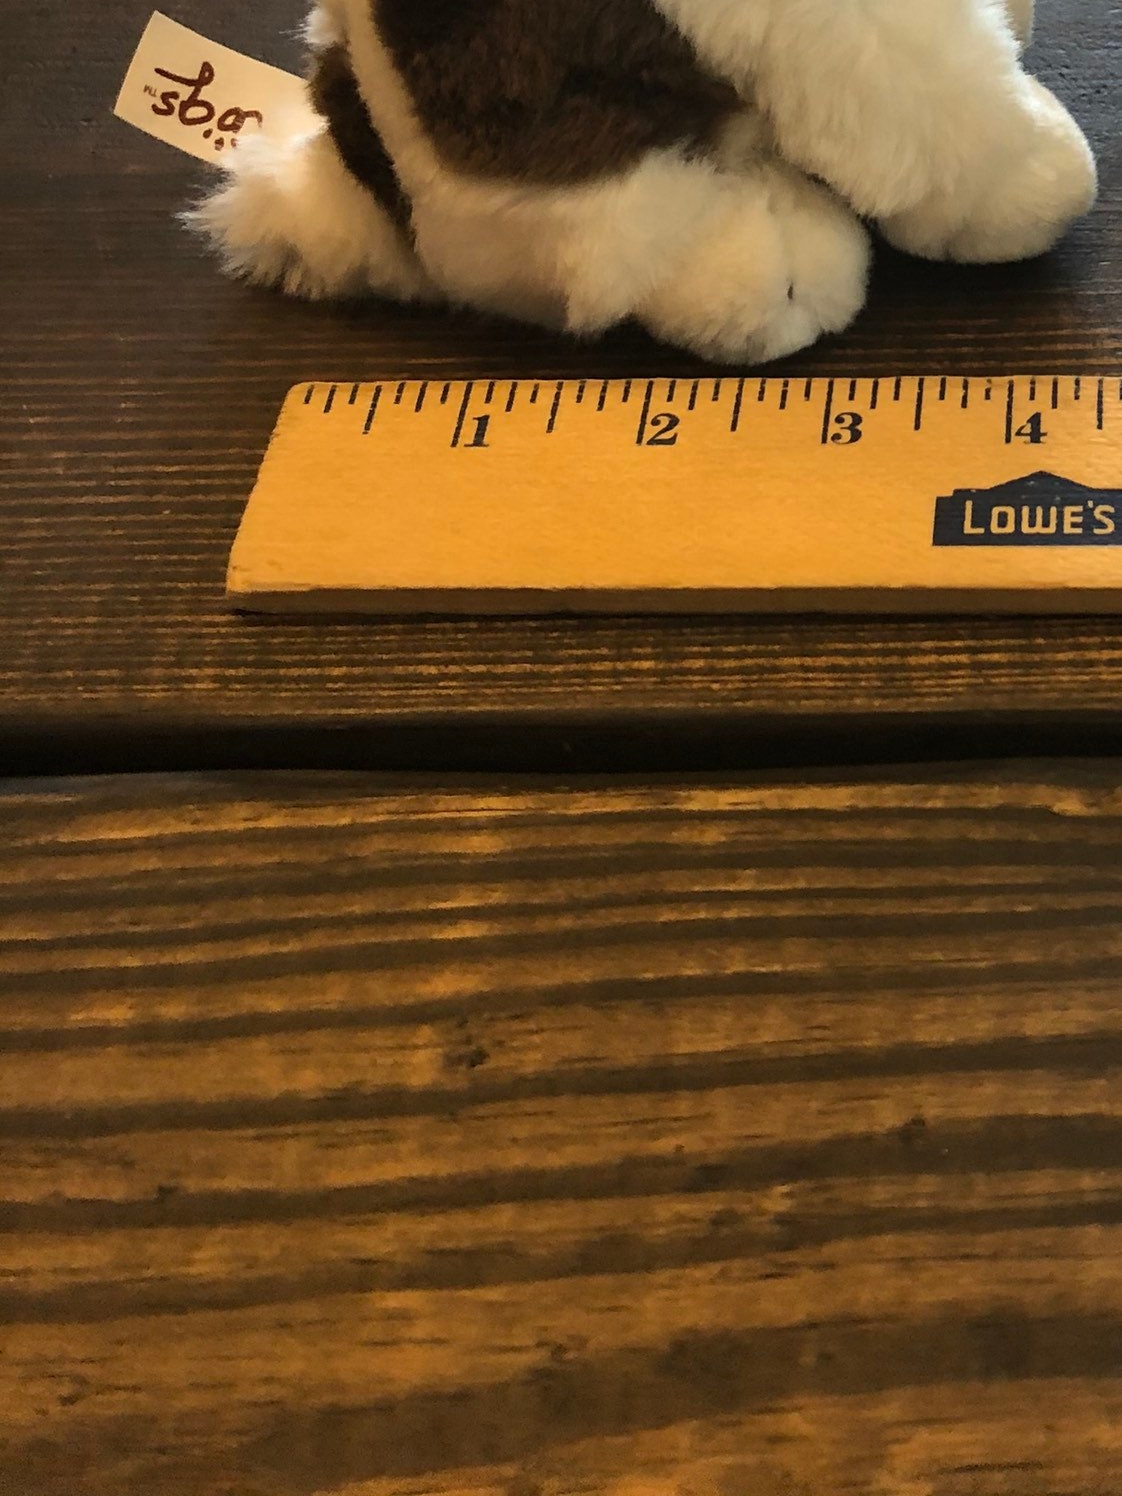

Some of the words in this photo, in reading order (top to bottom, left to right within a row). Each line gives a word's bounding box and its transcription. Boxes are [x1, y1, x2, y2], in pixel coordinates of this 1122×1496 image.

[463, 414, 491, 448] 1
[645, 412, 681, 446] 2
[829, 411, 863, 445] 3
[1014, 411, 1048, 445] 4
